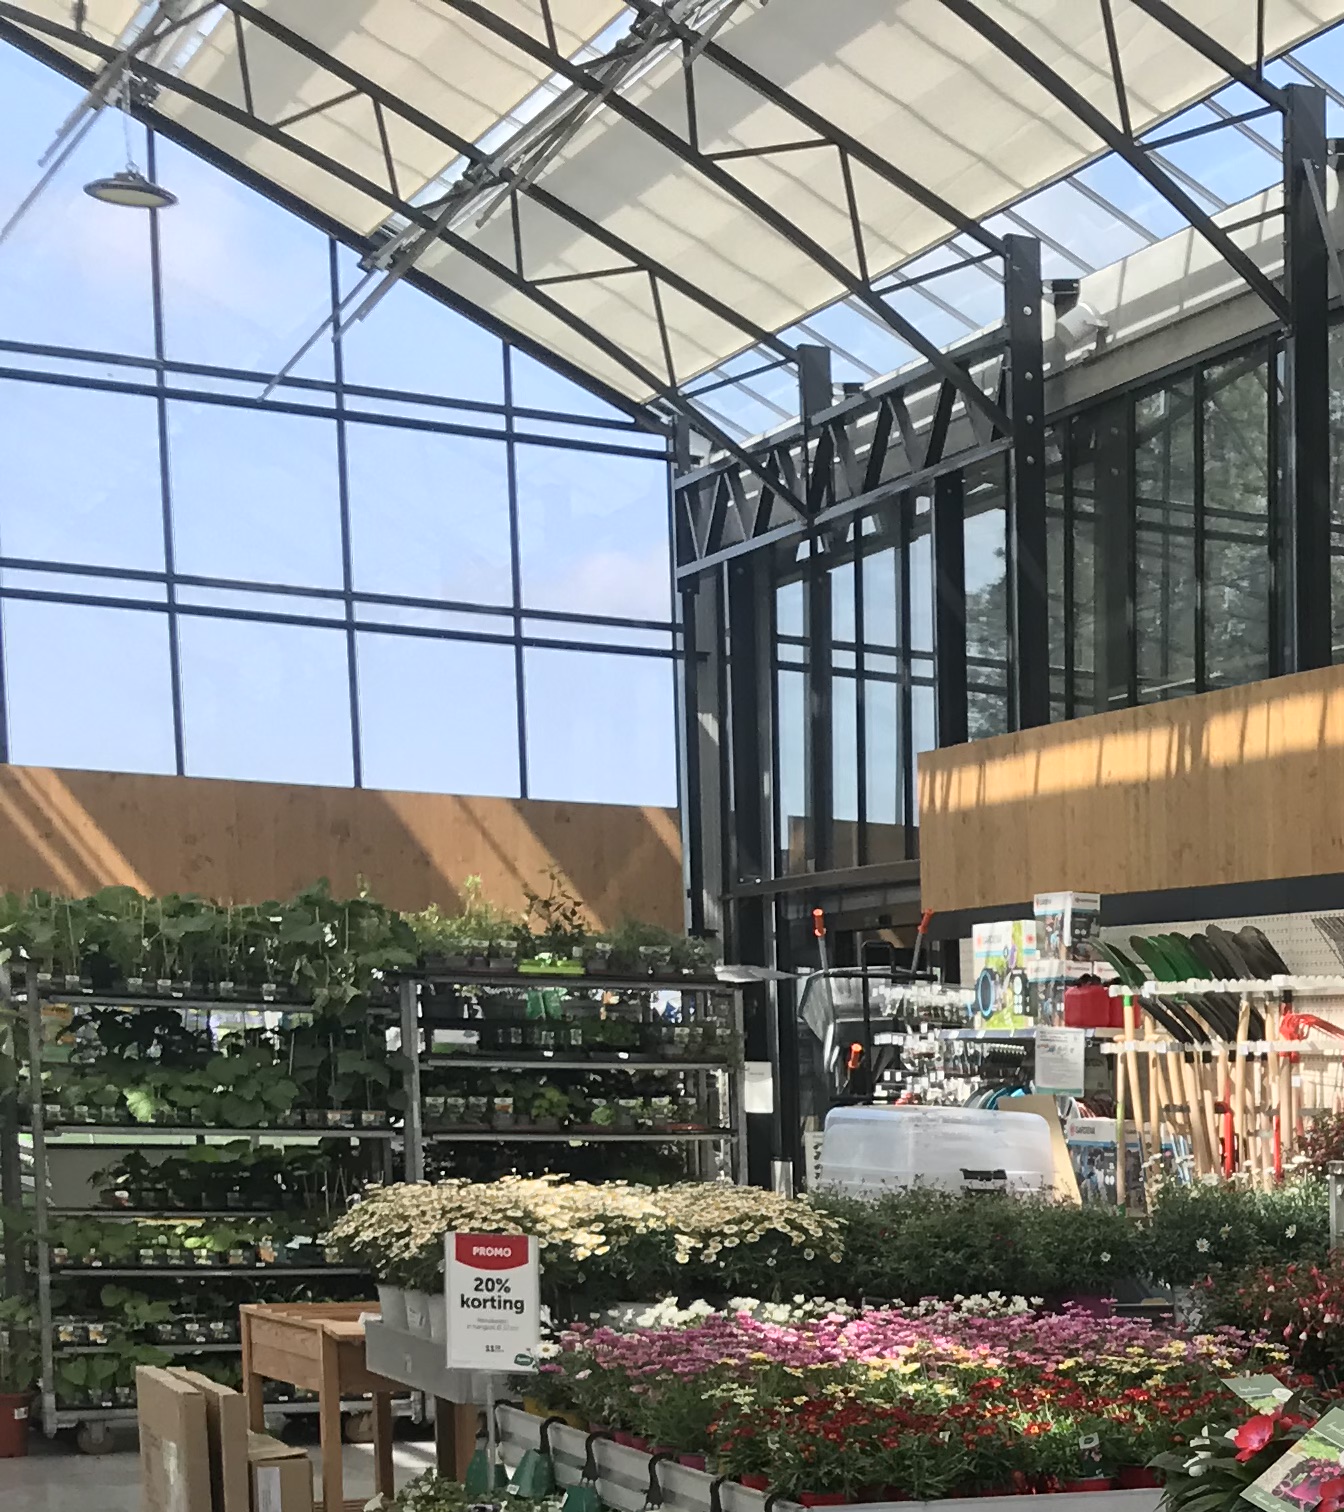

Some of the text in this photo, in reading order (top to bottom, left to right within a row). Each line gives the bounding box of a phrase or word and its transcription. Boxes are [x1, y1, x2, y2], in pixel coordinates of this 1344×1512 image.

[472, 1246, 512, 1258] PROMO
[474, 1277, 511, 1294] 20%
[460, 1294, 525, 1315] korting
